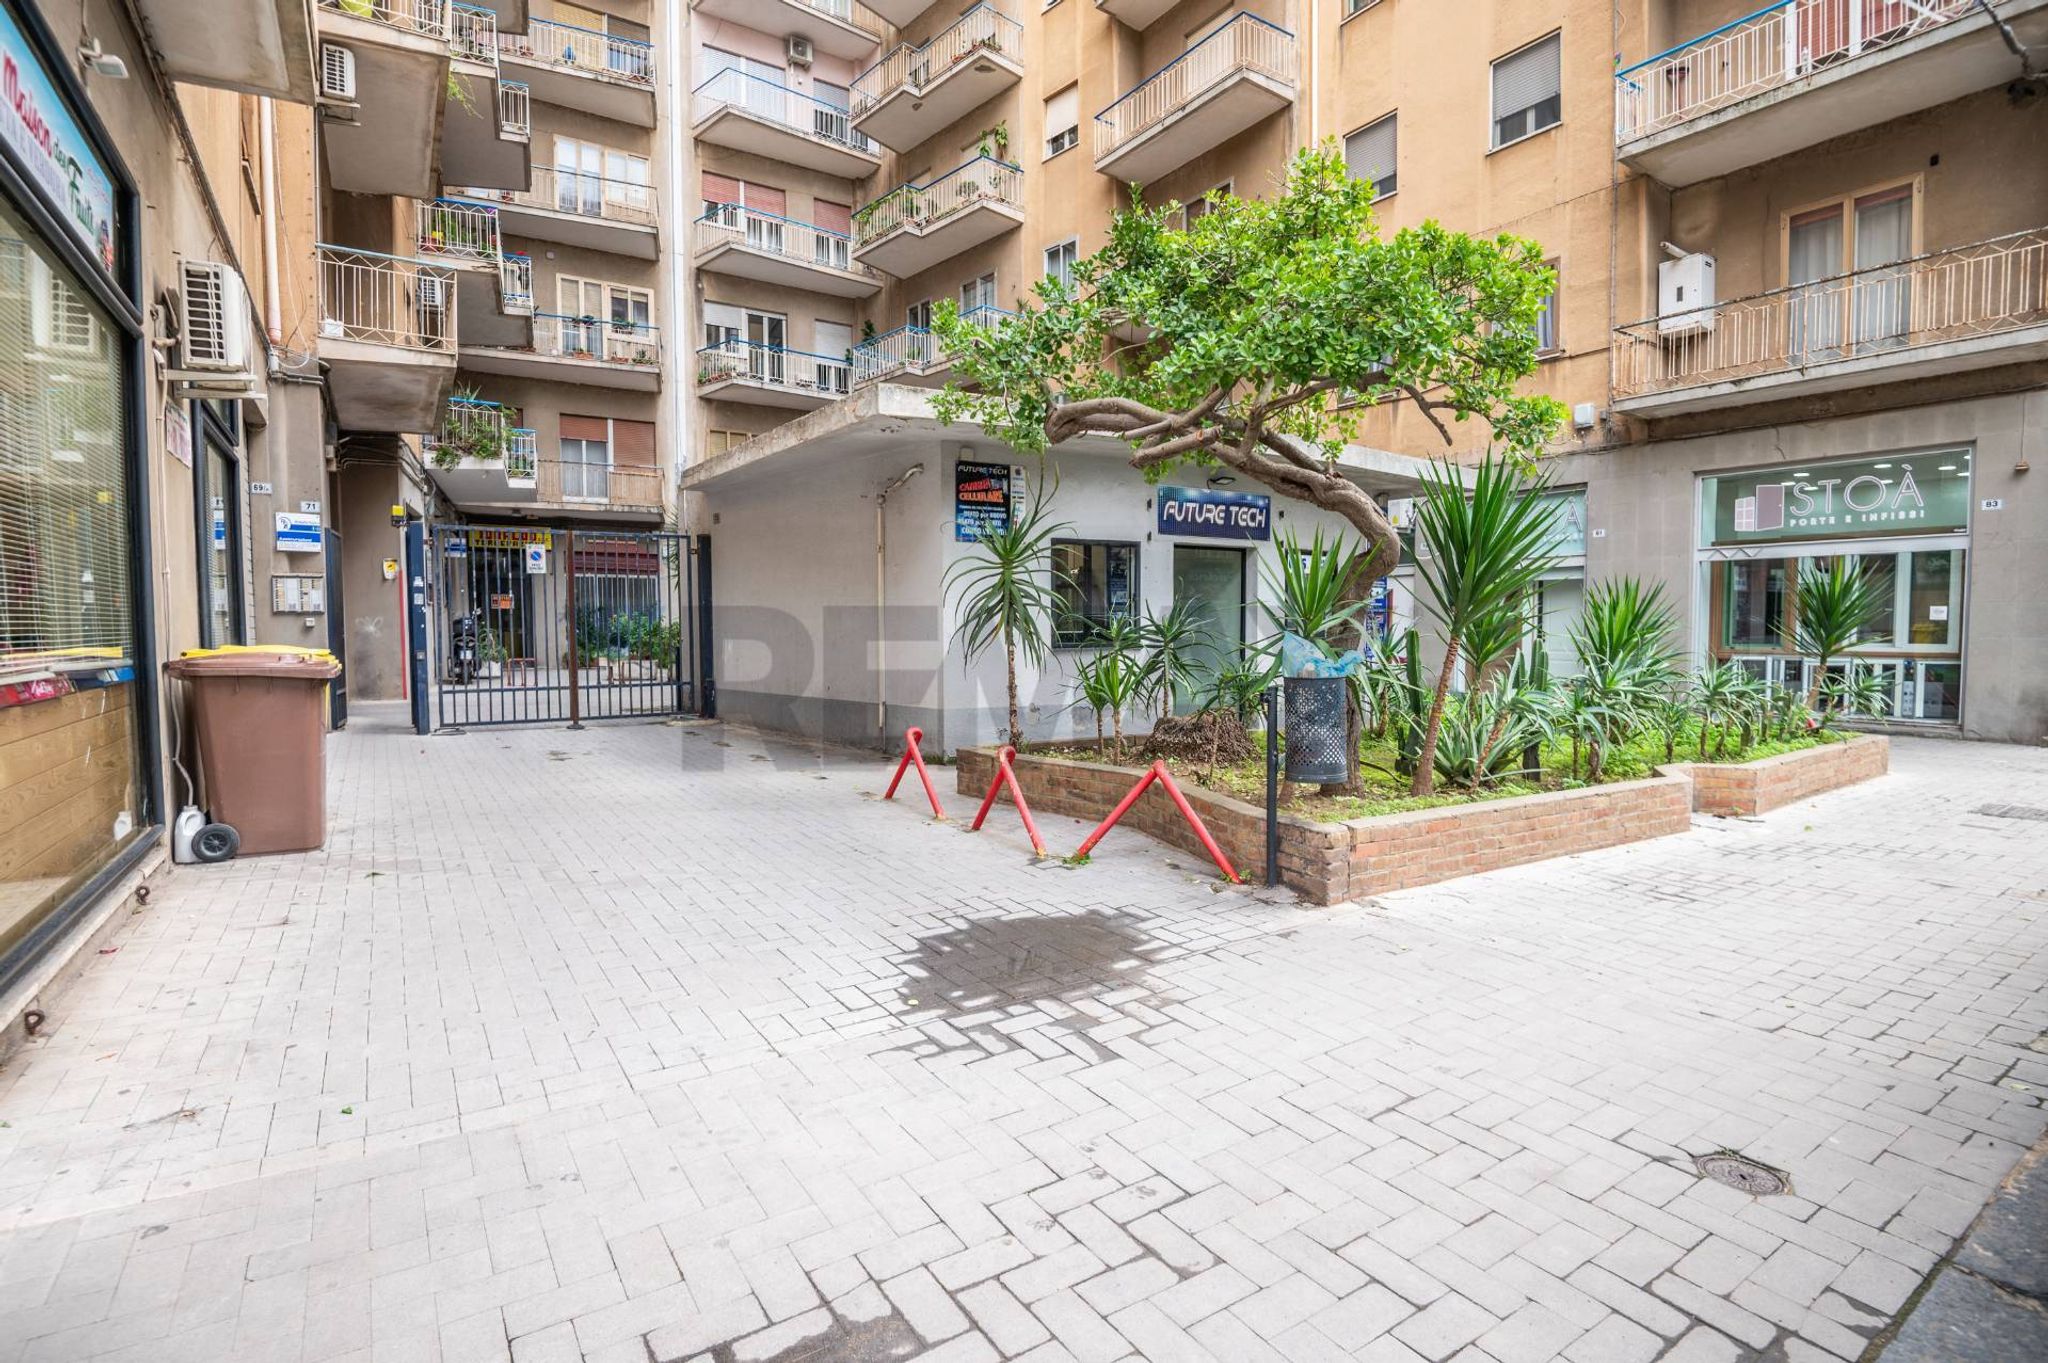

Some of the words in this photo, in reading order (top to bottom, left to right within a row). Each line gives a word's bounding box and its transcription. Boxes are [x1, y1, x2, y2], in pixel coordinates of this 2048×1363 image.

[3, 55, 52, 157] Maison
[957, 465, 988, 474] FUTURE
[989, 466, 1008, 475] TECH
[1789, 463, 1924, 517] STOÀ
[1163, 501, 1226, 525] FUTURE
[1229, 506, 1266, 528] TECH
[1789, 514, 1836, 528] PORTE
[1861, 510, 1926, 522] INFISSI
